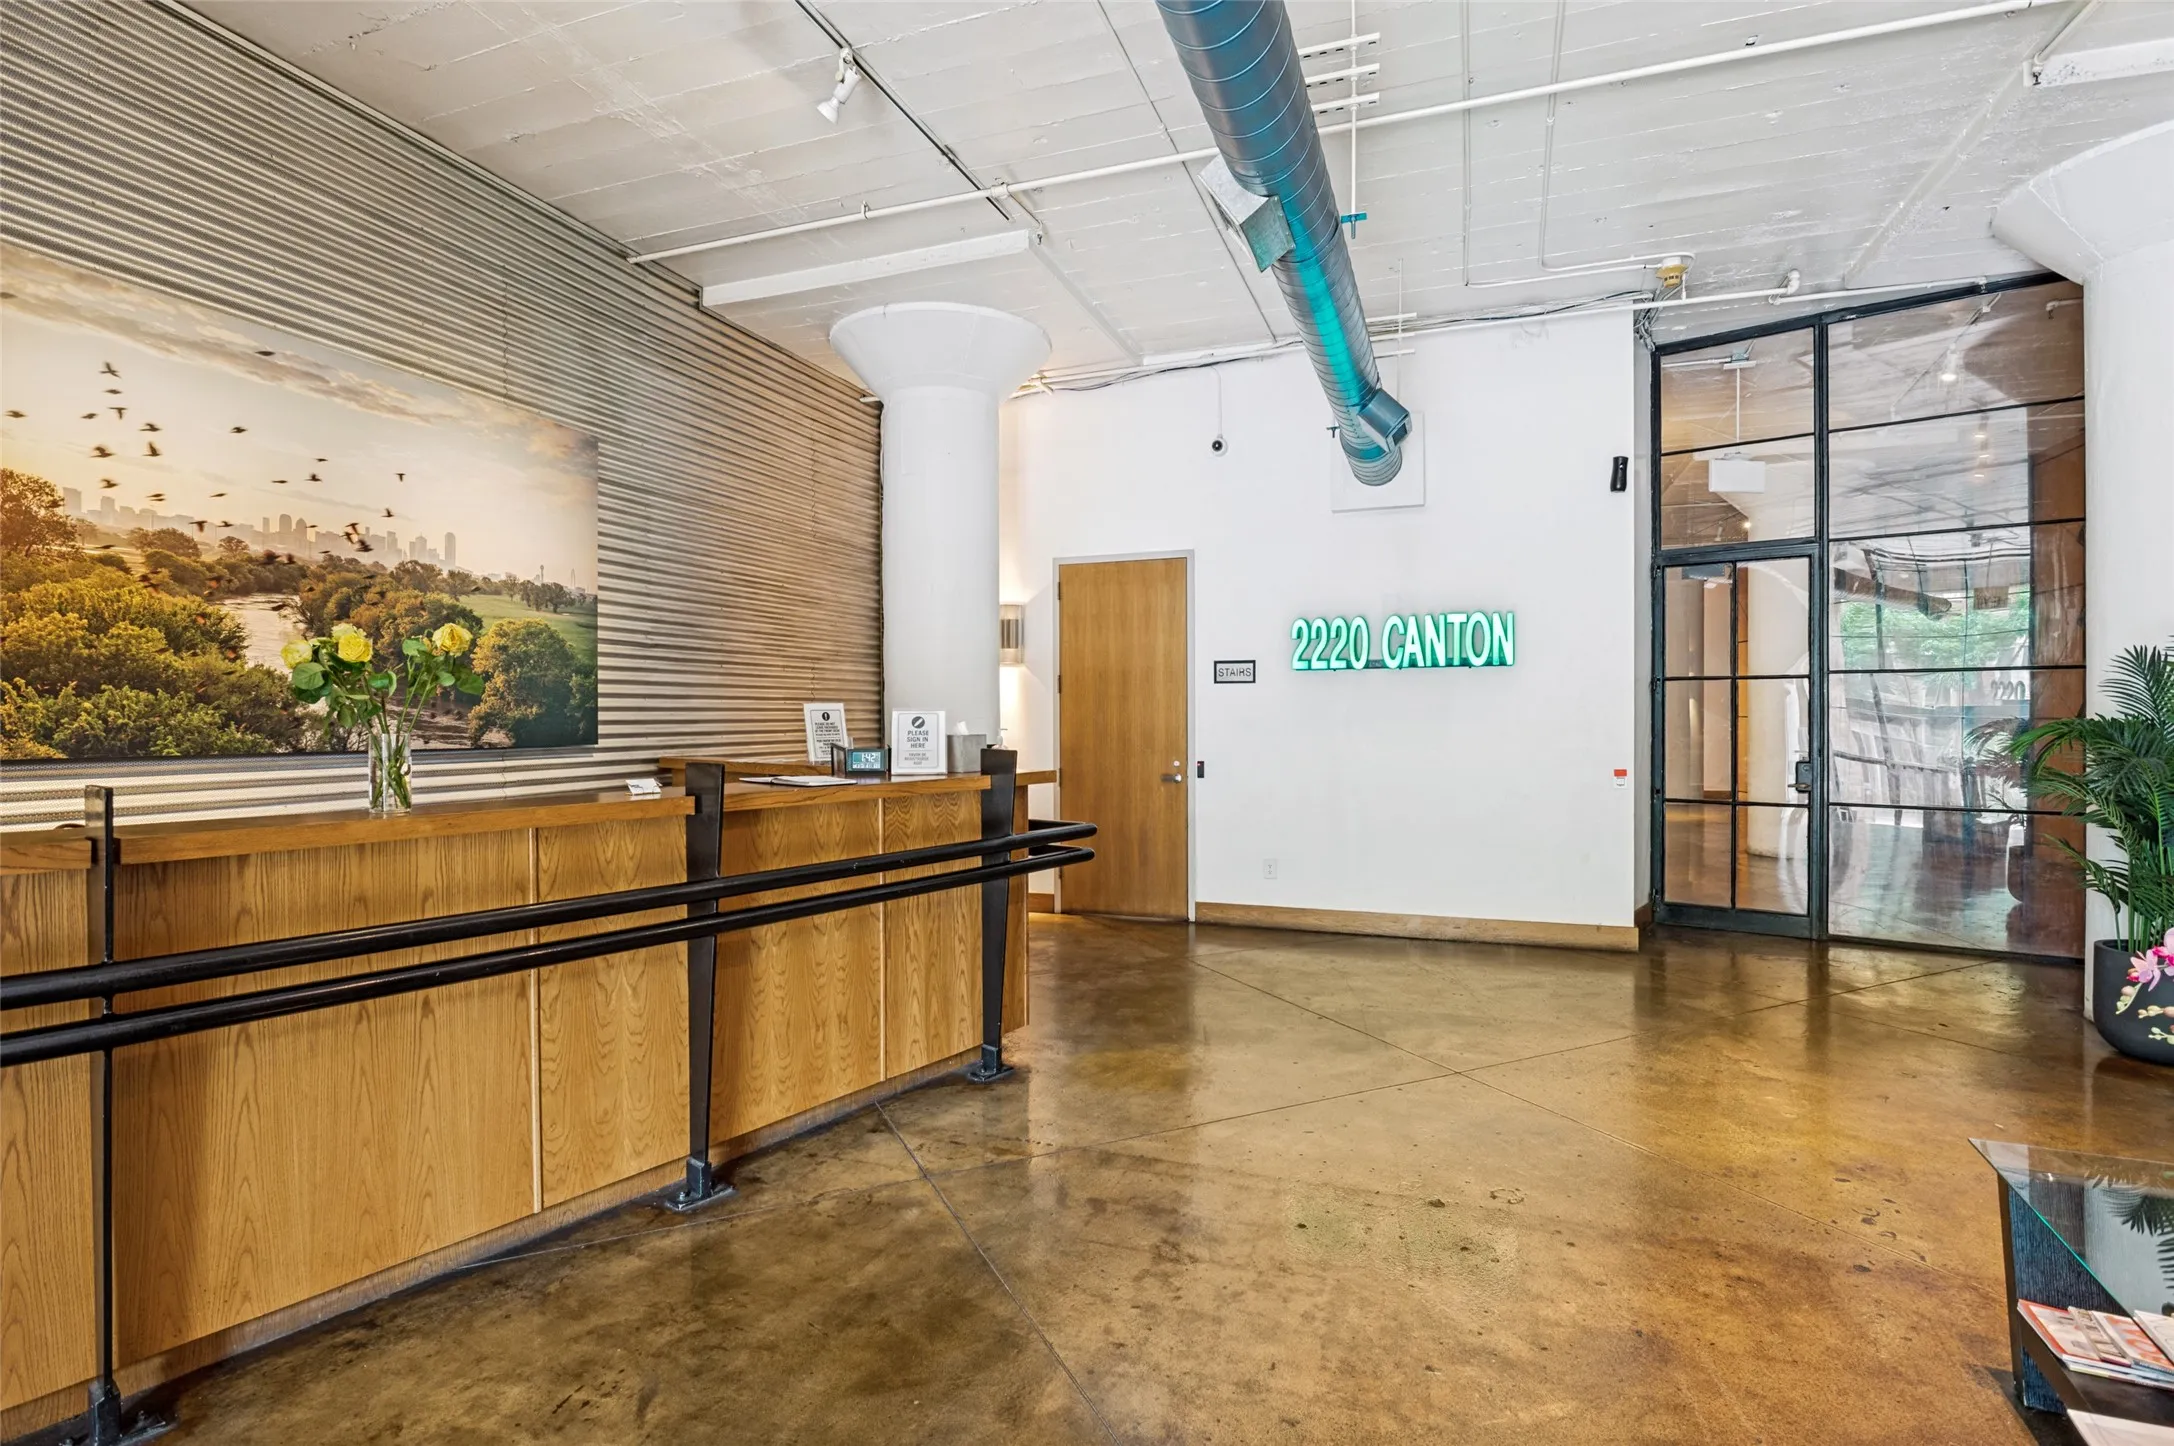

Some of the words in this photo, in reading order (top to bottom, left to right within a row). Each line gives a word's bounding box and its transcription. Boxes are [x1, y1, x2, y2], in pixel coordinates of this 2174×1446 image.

[1291, 617, 1370, 670] 2220
[1382, 611, 1515, 669] CANTON
[1218, 667, 1252, 677] STAIRS
